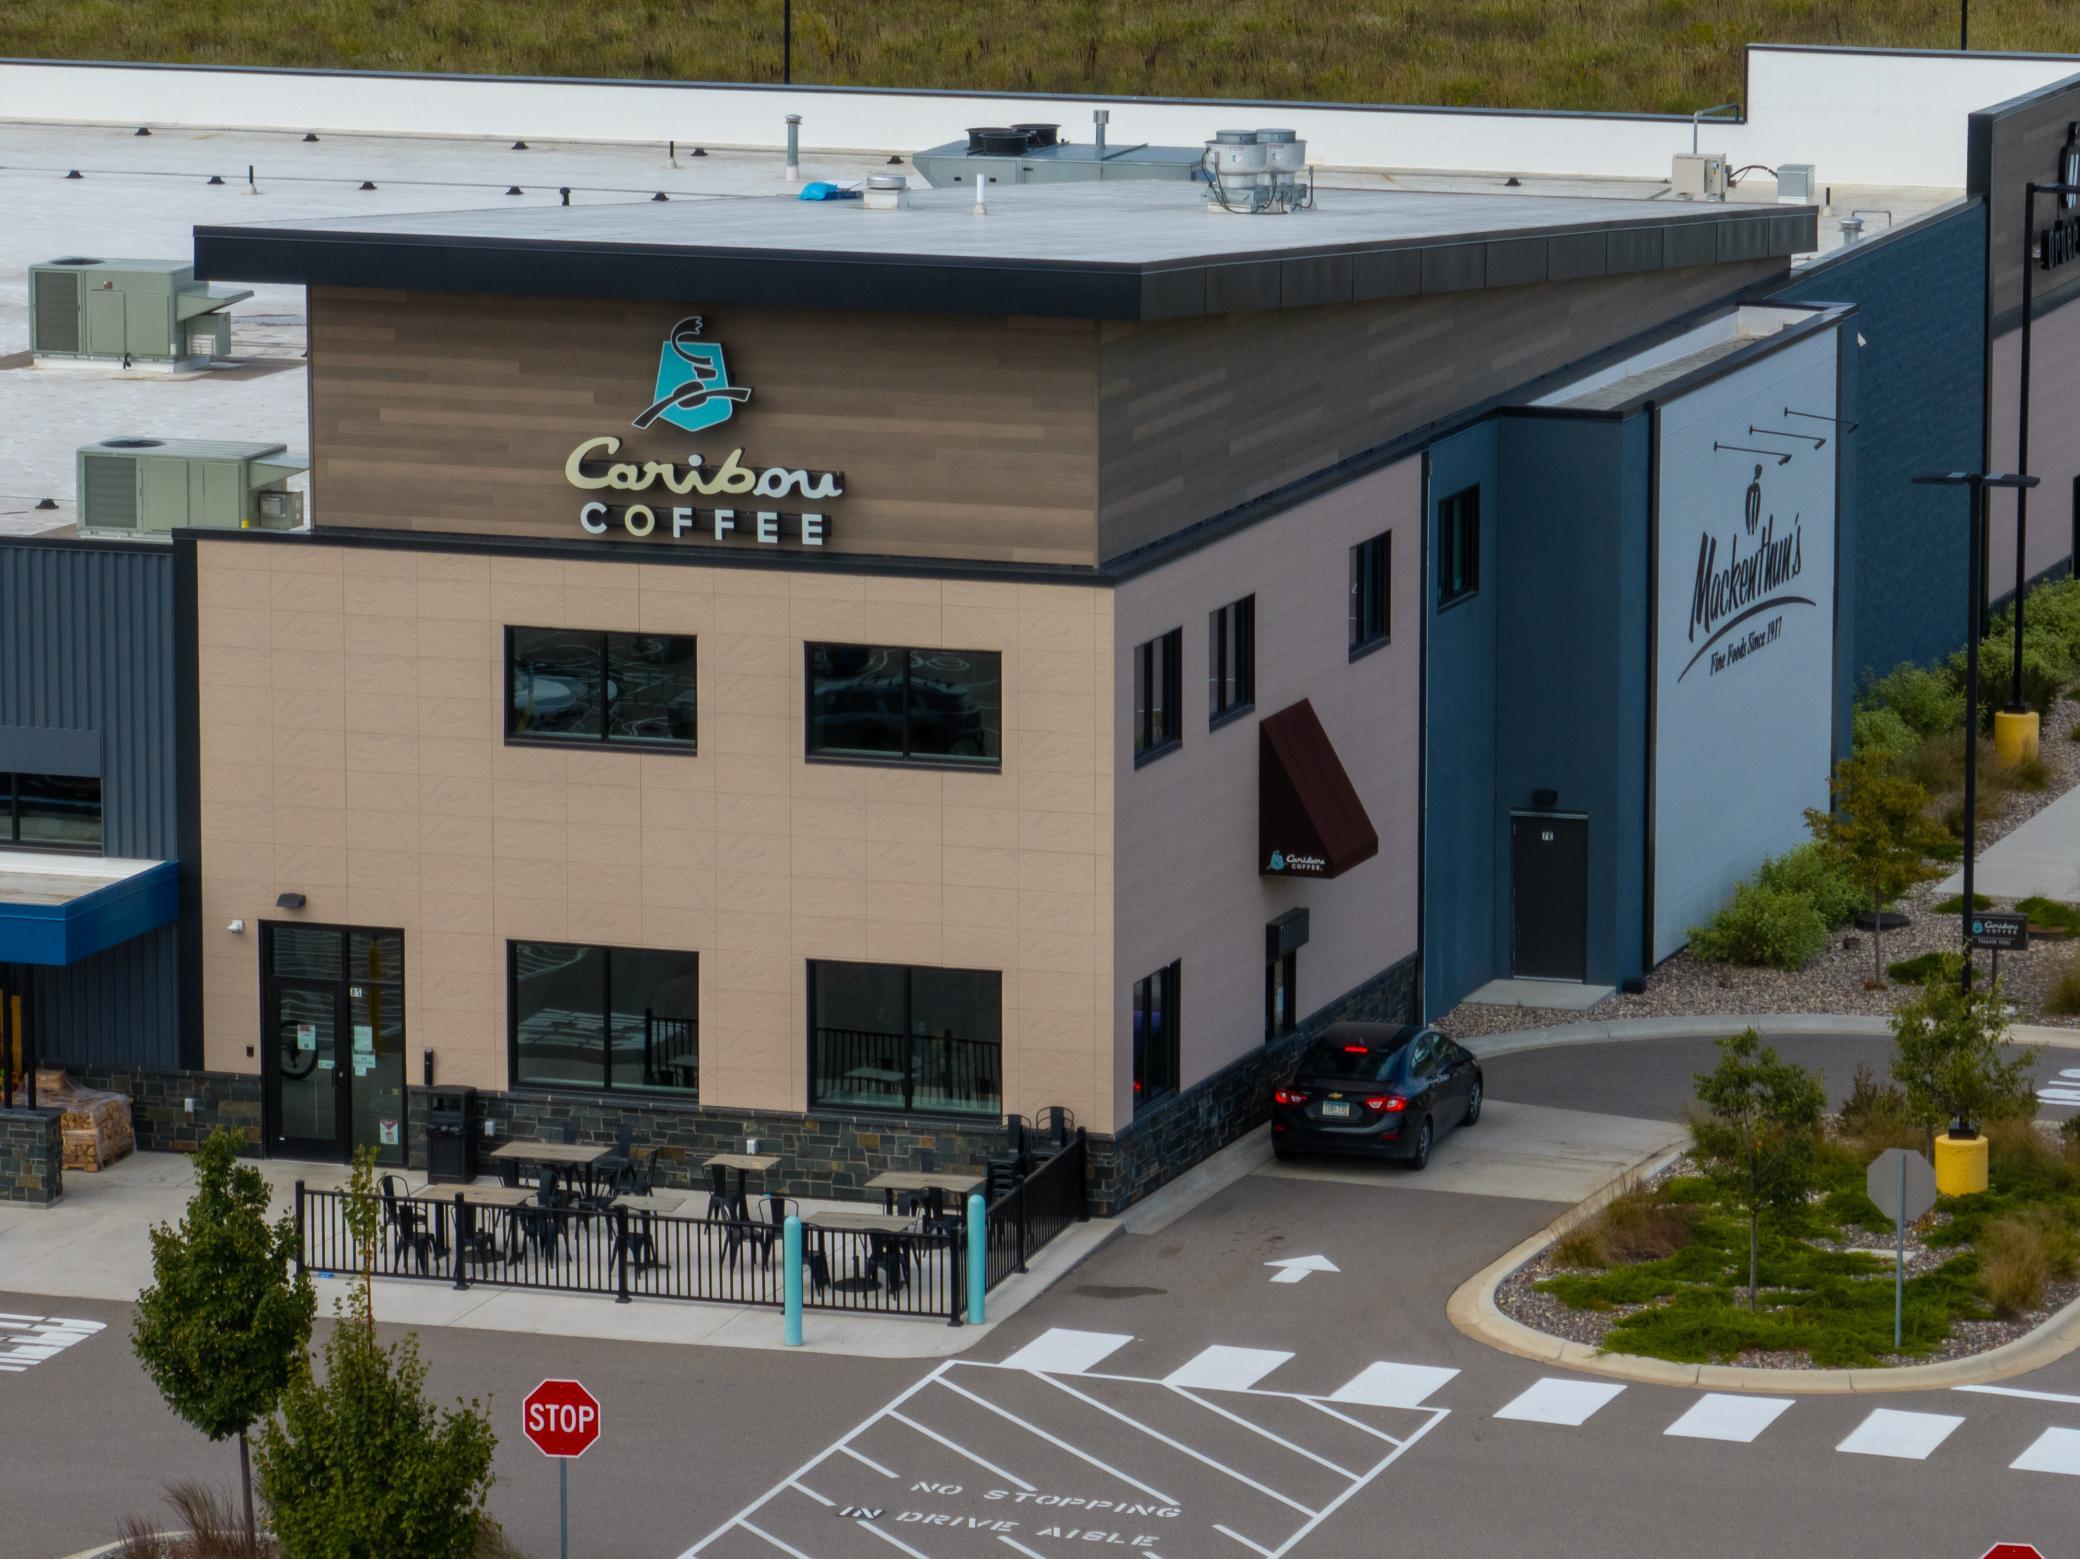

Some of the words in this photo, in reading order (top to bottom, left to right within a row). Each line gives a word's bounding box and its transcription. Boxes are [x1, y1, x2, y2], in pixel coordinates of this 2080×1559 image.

[565, 436, 843, 499] Caribou
[580, 501, 824, 546] COFFEE
[1710, 650, 1726, 676] Fine
[1727, 637, 1747, 667] Foods
[1747, 630, 1766, 655] Since
[1767, 616, 1783, 644] 1917
[1286, 854, 1326, 865] Caribou
[1291, 863, 1321, 871] COFFEE
[528, 1403, 595, 1433] STOP
[909, 1481, 963, 1495] NO
[983, 1489, 1182, 1518] STOPPING
[838, 1506, 883, 1519] IN
[895, 1511, 1020, 1532] DRIVE
[1036, 1526, 1160, 1547] AISLE
